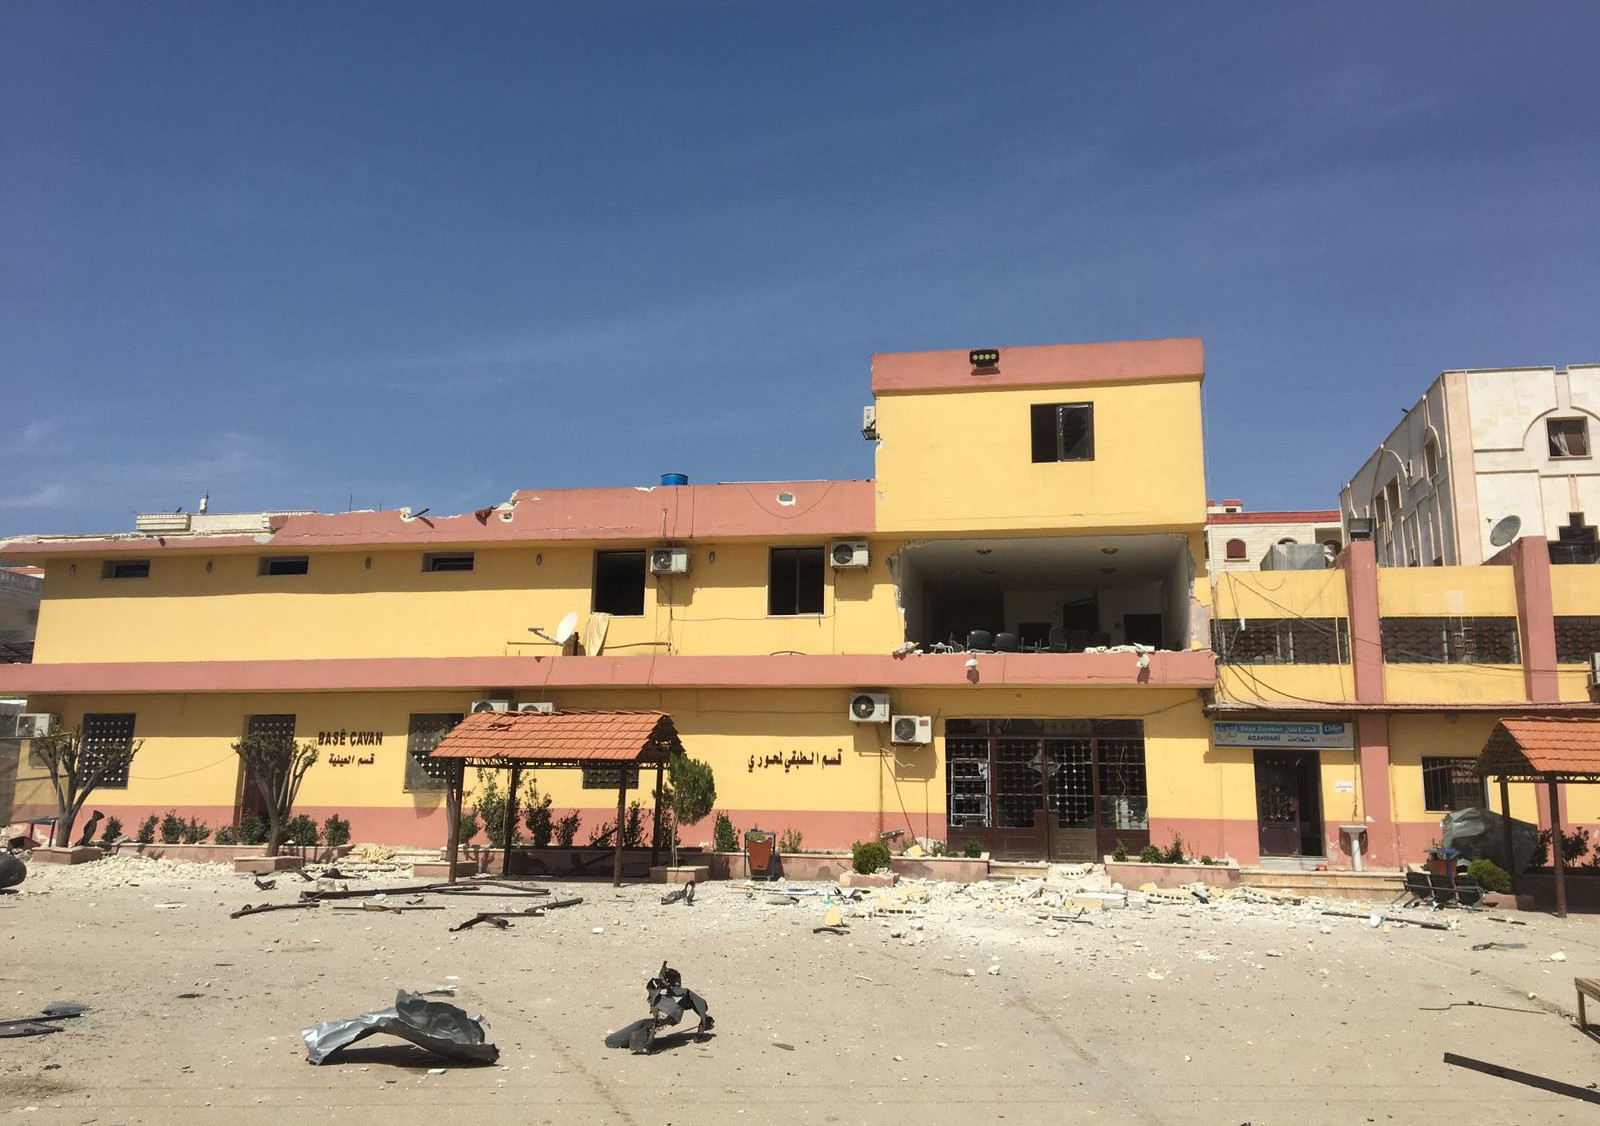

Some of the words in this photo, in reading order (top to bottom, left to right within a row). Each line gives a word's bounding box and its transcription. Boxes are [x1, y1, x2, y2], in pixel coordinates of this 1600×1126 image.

[350, 731, 383, 747] ÇAVAN
[328, 753, 355, 767] العينية
[357, 753, 376, 767] قسم
[784, 750, 820, 774] الطبقي
[821, 748, 843, 771] قسم
